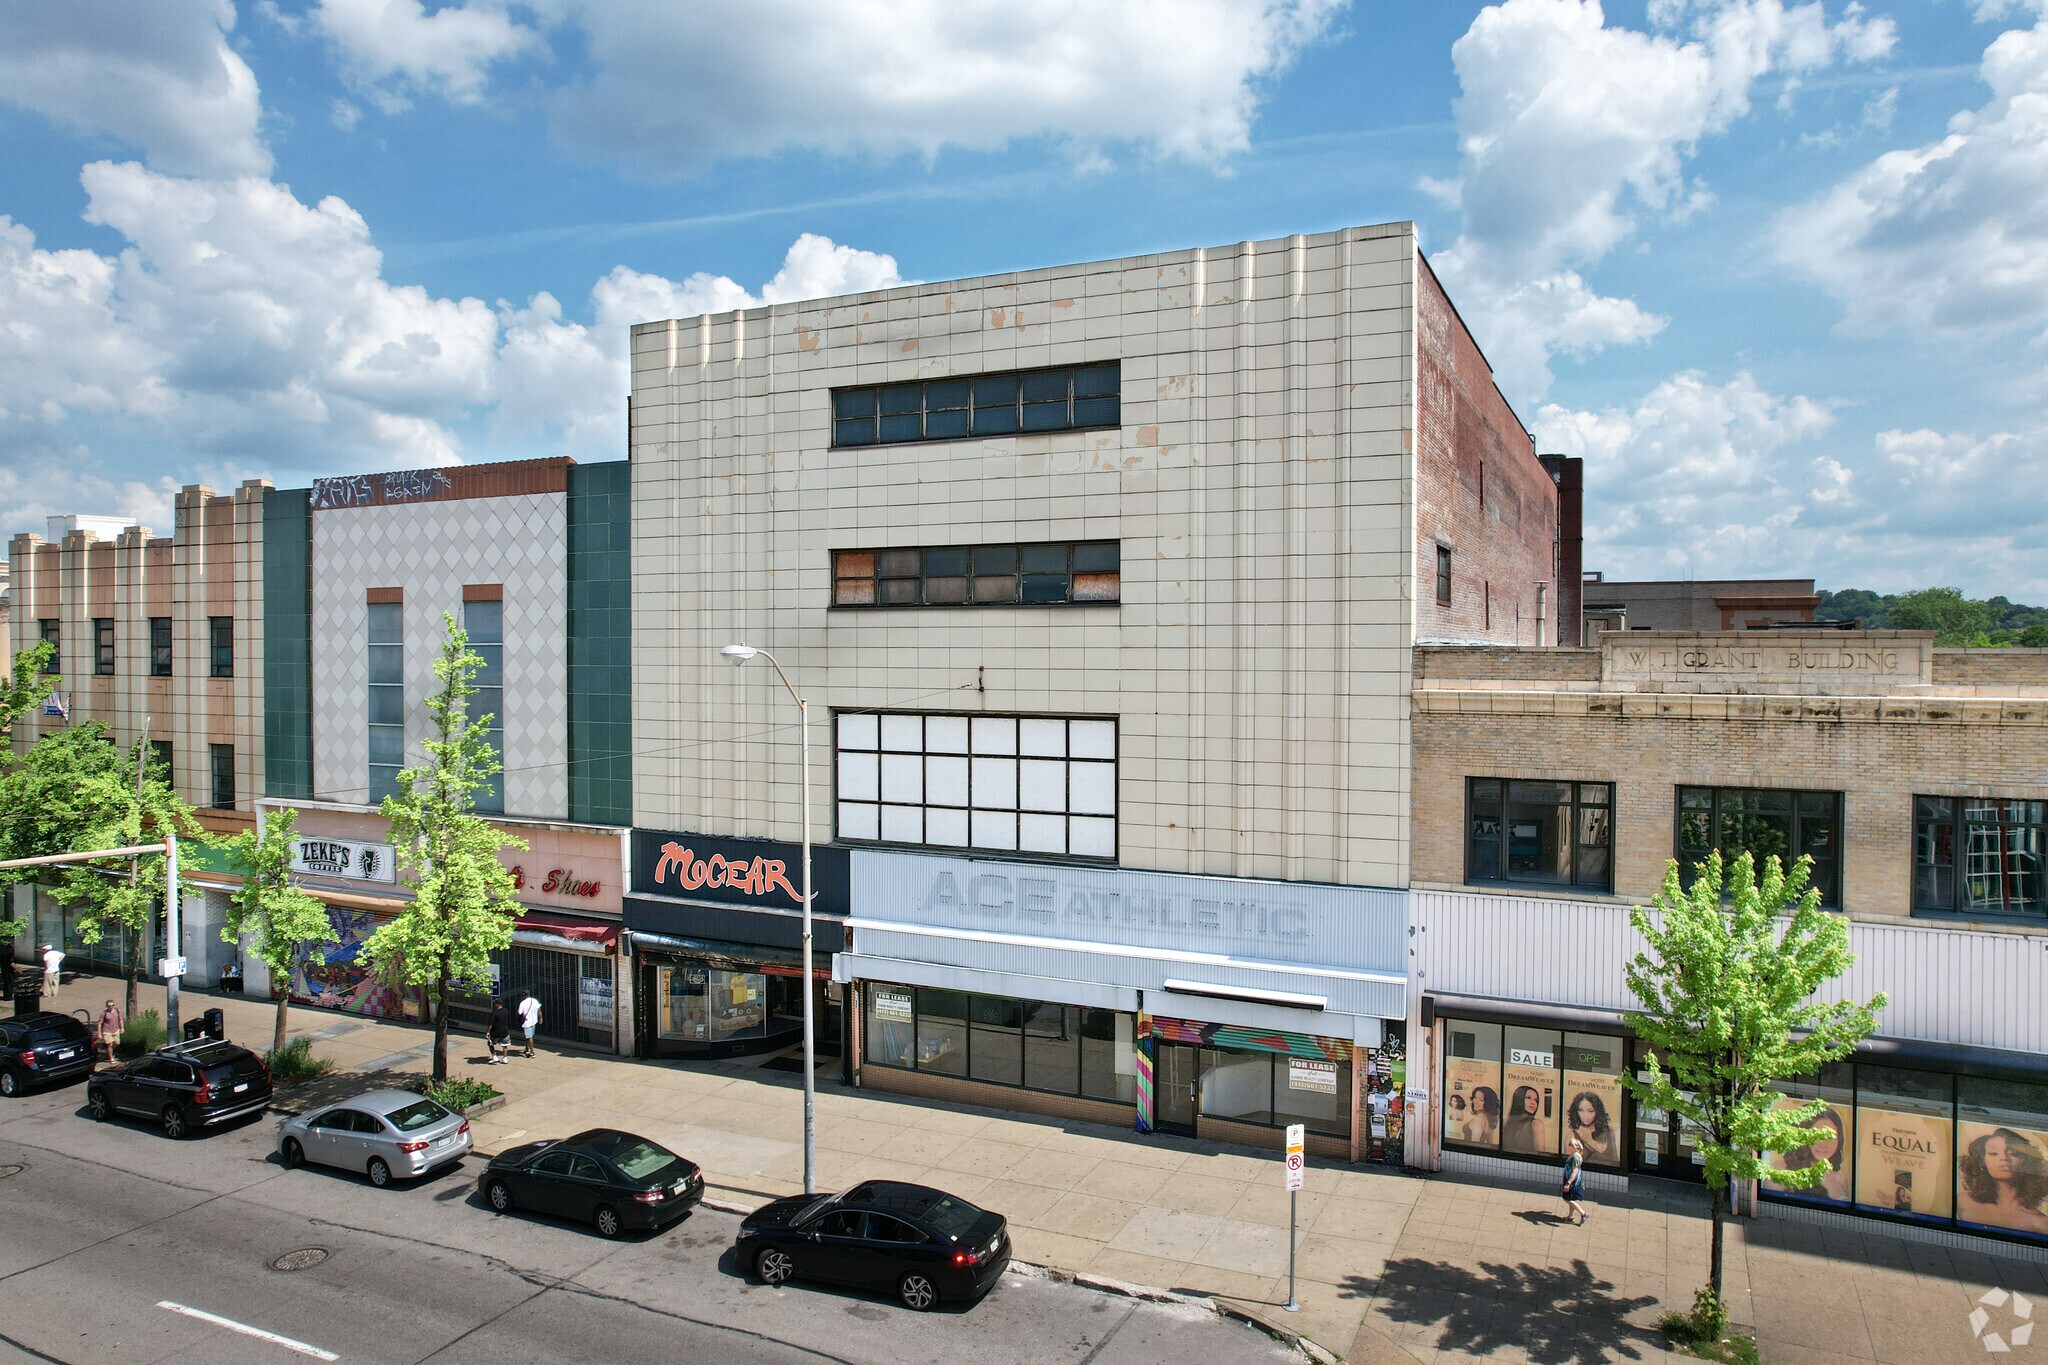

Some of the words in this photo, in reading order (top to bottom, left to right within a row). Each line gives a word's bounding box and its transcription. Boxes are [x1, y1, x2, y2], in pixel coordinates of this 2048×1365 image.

[1683, 652, 1760, 668] GRANT
[1786, 652, 1899, 670] BUILDING
[300, 841, 350, 868] ZEKE'S
[310, 863, 342, 873] COFFEE
[541, 868, 601, 897] Shoes
[923, 871, 1057, 922] ACE
[1061, 889, 1310, 937] ATHLETIC
[597, 1000, 613, 1009] SAL
[1291, 1060, 1308, 1068] FOR
[1309, 1062, 1335, 1071] LEASE
[1512, 1051, 1551, 1066] SALE
[1872, 1132, 1936, 1154] EQUAL
[1883, 1155, 1924, 1169] WEAVE
